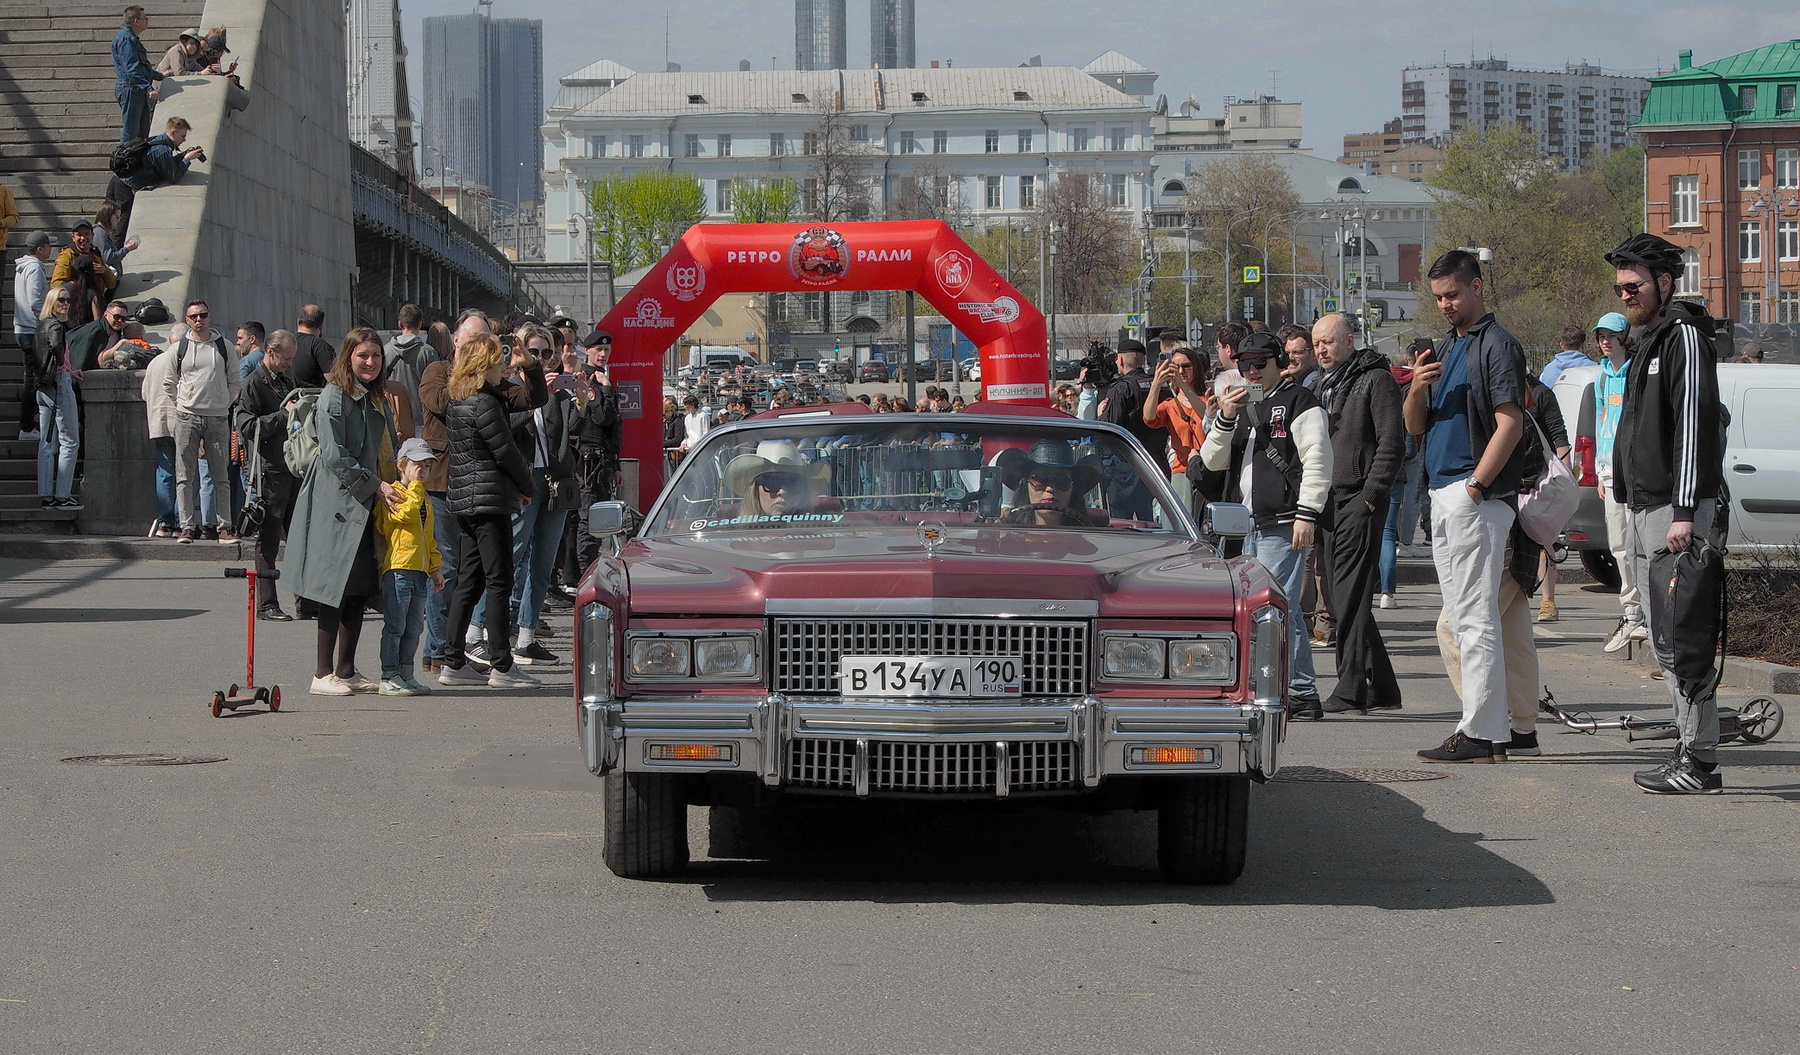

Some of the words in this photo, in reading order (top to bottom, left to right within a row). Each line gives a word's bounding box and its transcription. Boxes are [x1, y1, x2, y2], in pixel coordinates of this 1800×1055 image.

[727, 250, 782, 264] РЕТРО
[857, 249, 912, 261] РАЛЛИ
[623, 319, 675, 329] НАСЛЕДИЕ
[974, 660, 1016, 683] 190
[982, 683, 1004, 693] RUS
